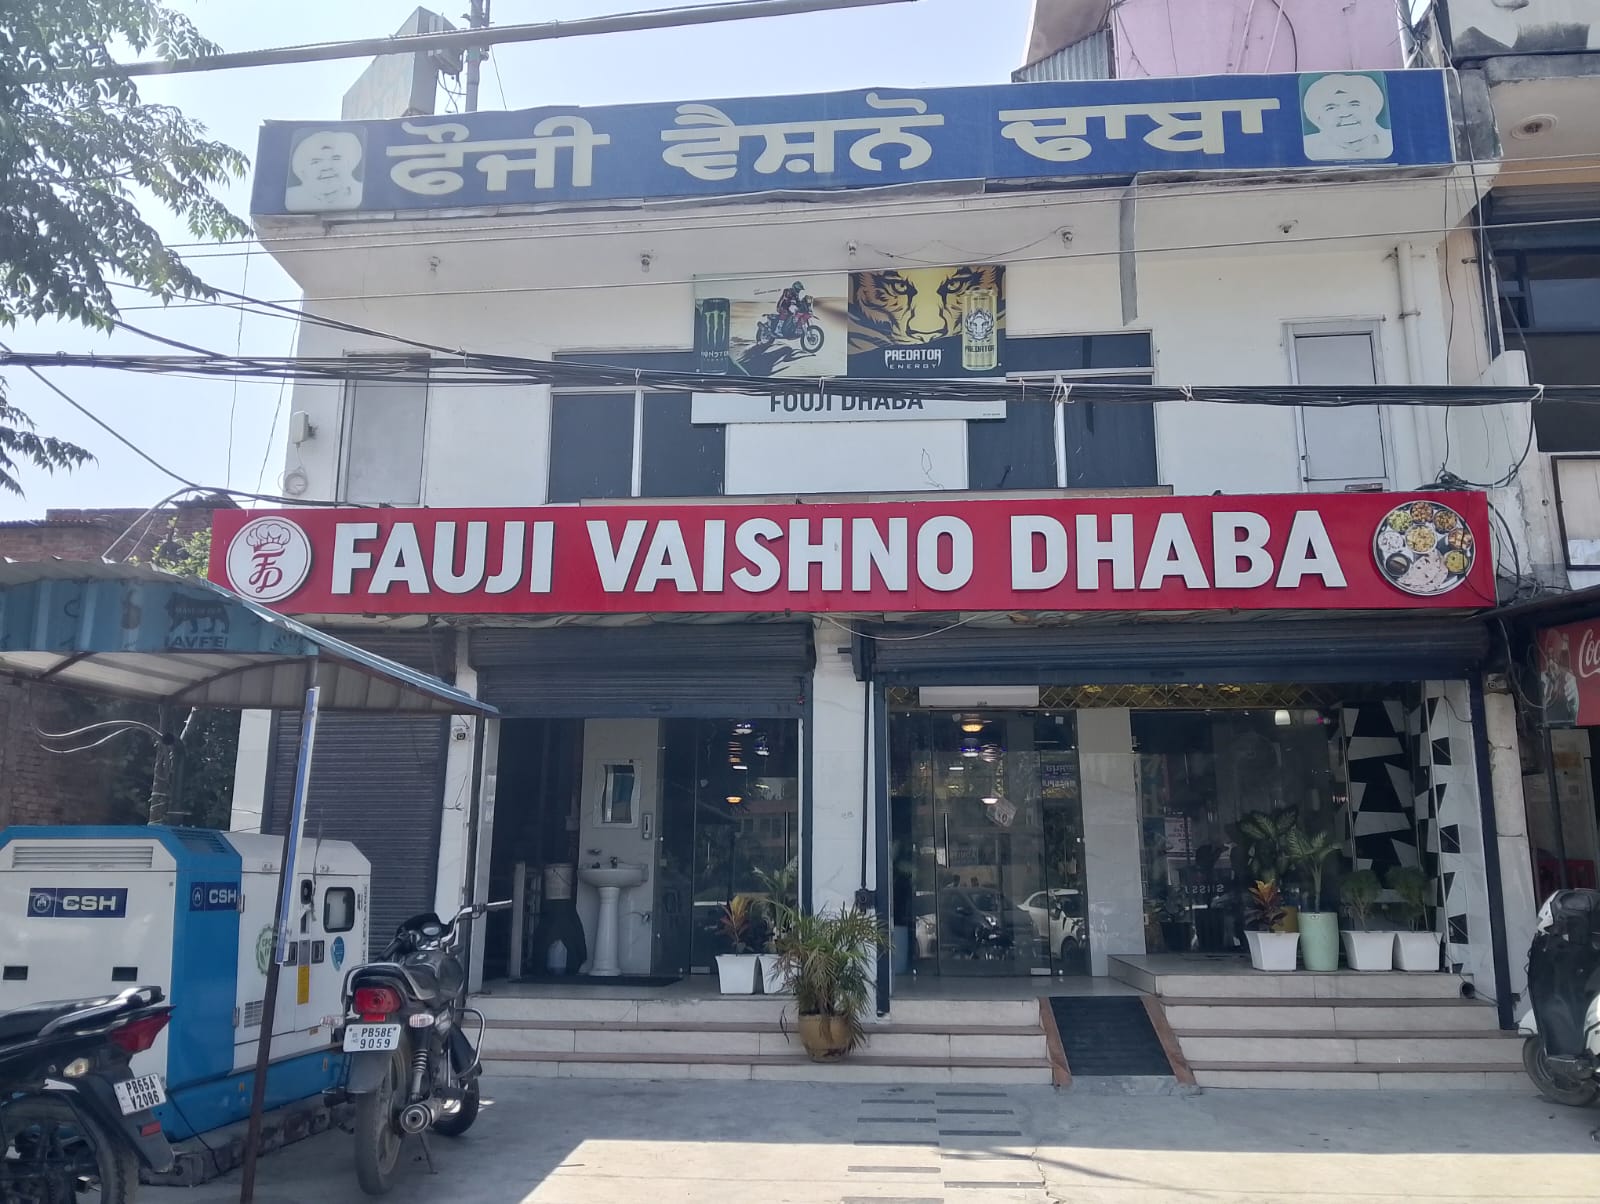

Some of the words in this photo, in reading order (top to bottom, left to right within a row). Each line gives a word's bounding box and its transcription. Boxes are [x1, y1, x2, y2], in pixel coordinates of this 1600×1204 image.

[386, 115, 611, 195] ਫੌਜੀ
[660, 92, 945, 181] ਵੈਸ਼ਨੋ
[998, 97, 1281, 162] ਢਾਬਾ
[884, 348, 942, 368] PREDATOR
[331, 520, 555, 594] FAUJI
[585, 514, 975, 593] VAISHNO
[1010, 509, 1348, 591] DHABA
[62, 895, 117, 911] CSH
[208, 889, 237, 904] CSH
[361, 1027, 393, 1038] PB58E
[360, 1038, 391, 1049] 9059
[125, 1076, 156, 1097] PB65A
[130, 1090, 160, 1110] Y2086
